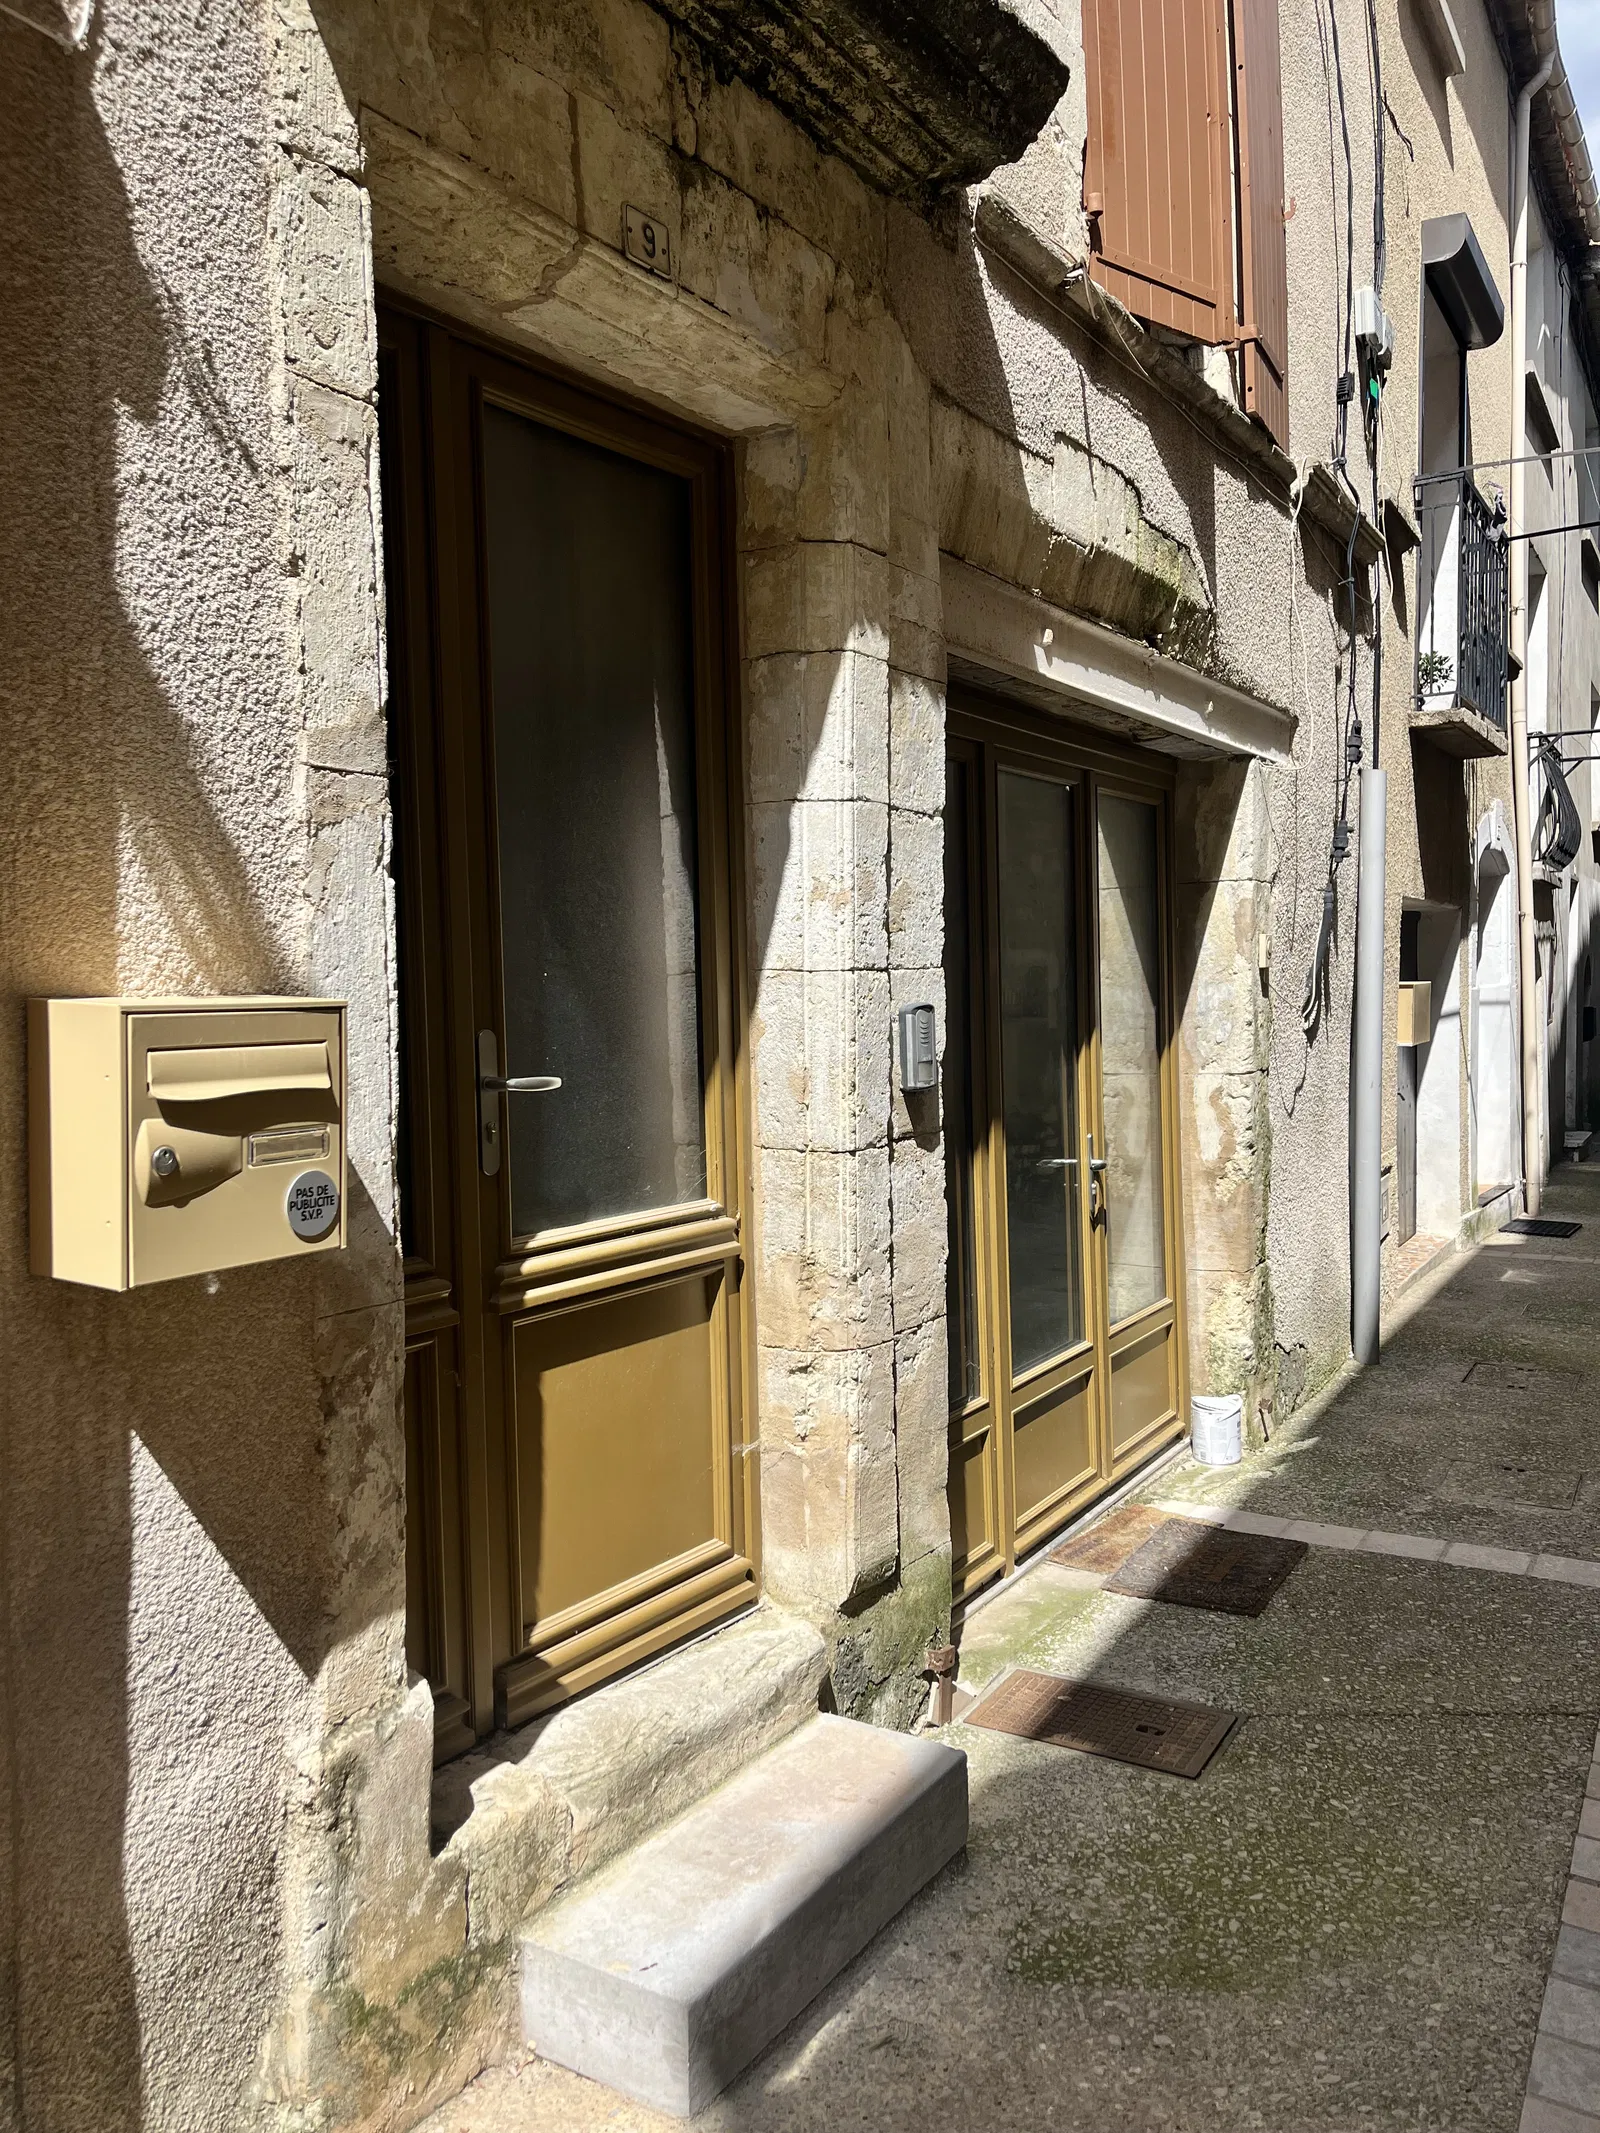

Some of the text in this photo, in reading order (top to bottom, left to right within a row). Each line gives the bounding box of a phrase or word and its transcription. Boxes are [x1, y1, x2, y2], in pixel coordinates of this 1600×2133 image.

[643, 223, 656, 259] 9
[296, 1184, 329, 1199] PAS DE
[289, 1195, 335, 1211] PUBLICITE
[301, 1208, 324, 1221] S.V.P.
